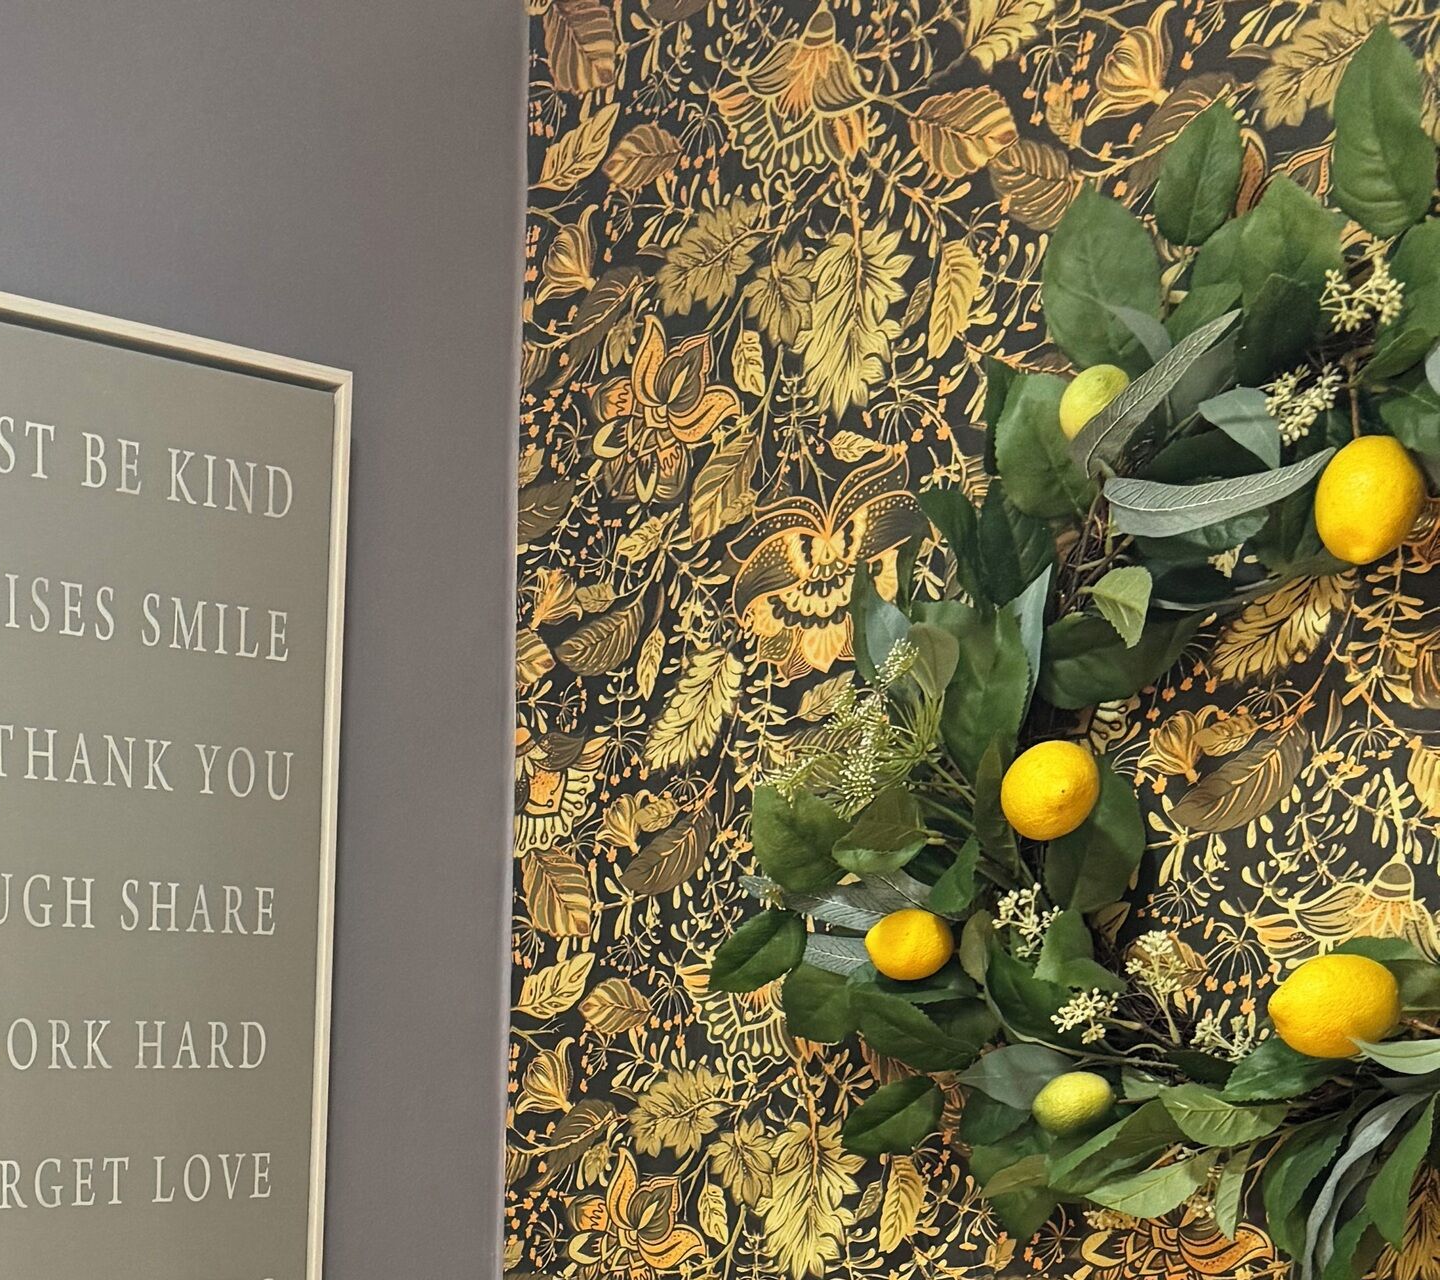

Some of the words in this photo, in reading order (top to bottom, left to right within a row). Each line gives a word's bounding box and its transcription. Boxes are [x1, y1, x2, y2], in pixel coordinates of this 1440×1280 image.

[81, 432, 142, 495] BE
[167, 448, 292, 518] KIND
[141, 593, 288, 661] SMILE
[195, 744, 294, 800] YOU
[121, 879, 275, 935] SHARE
[134, 1021, 266, 1069] HARD
[152, 1153, 271, 1202] LOVE
